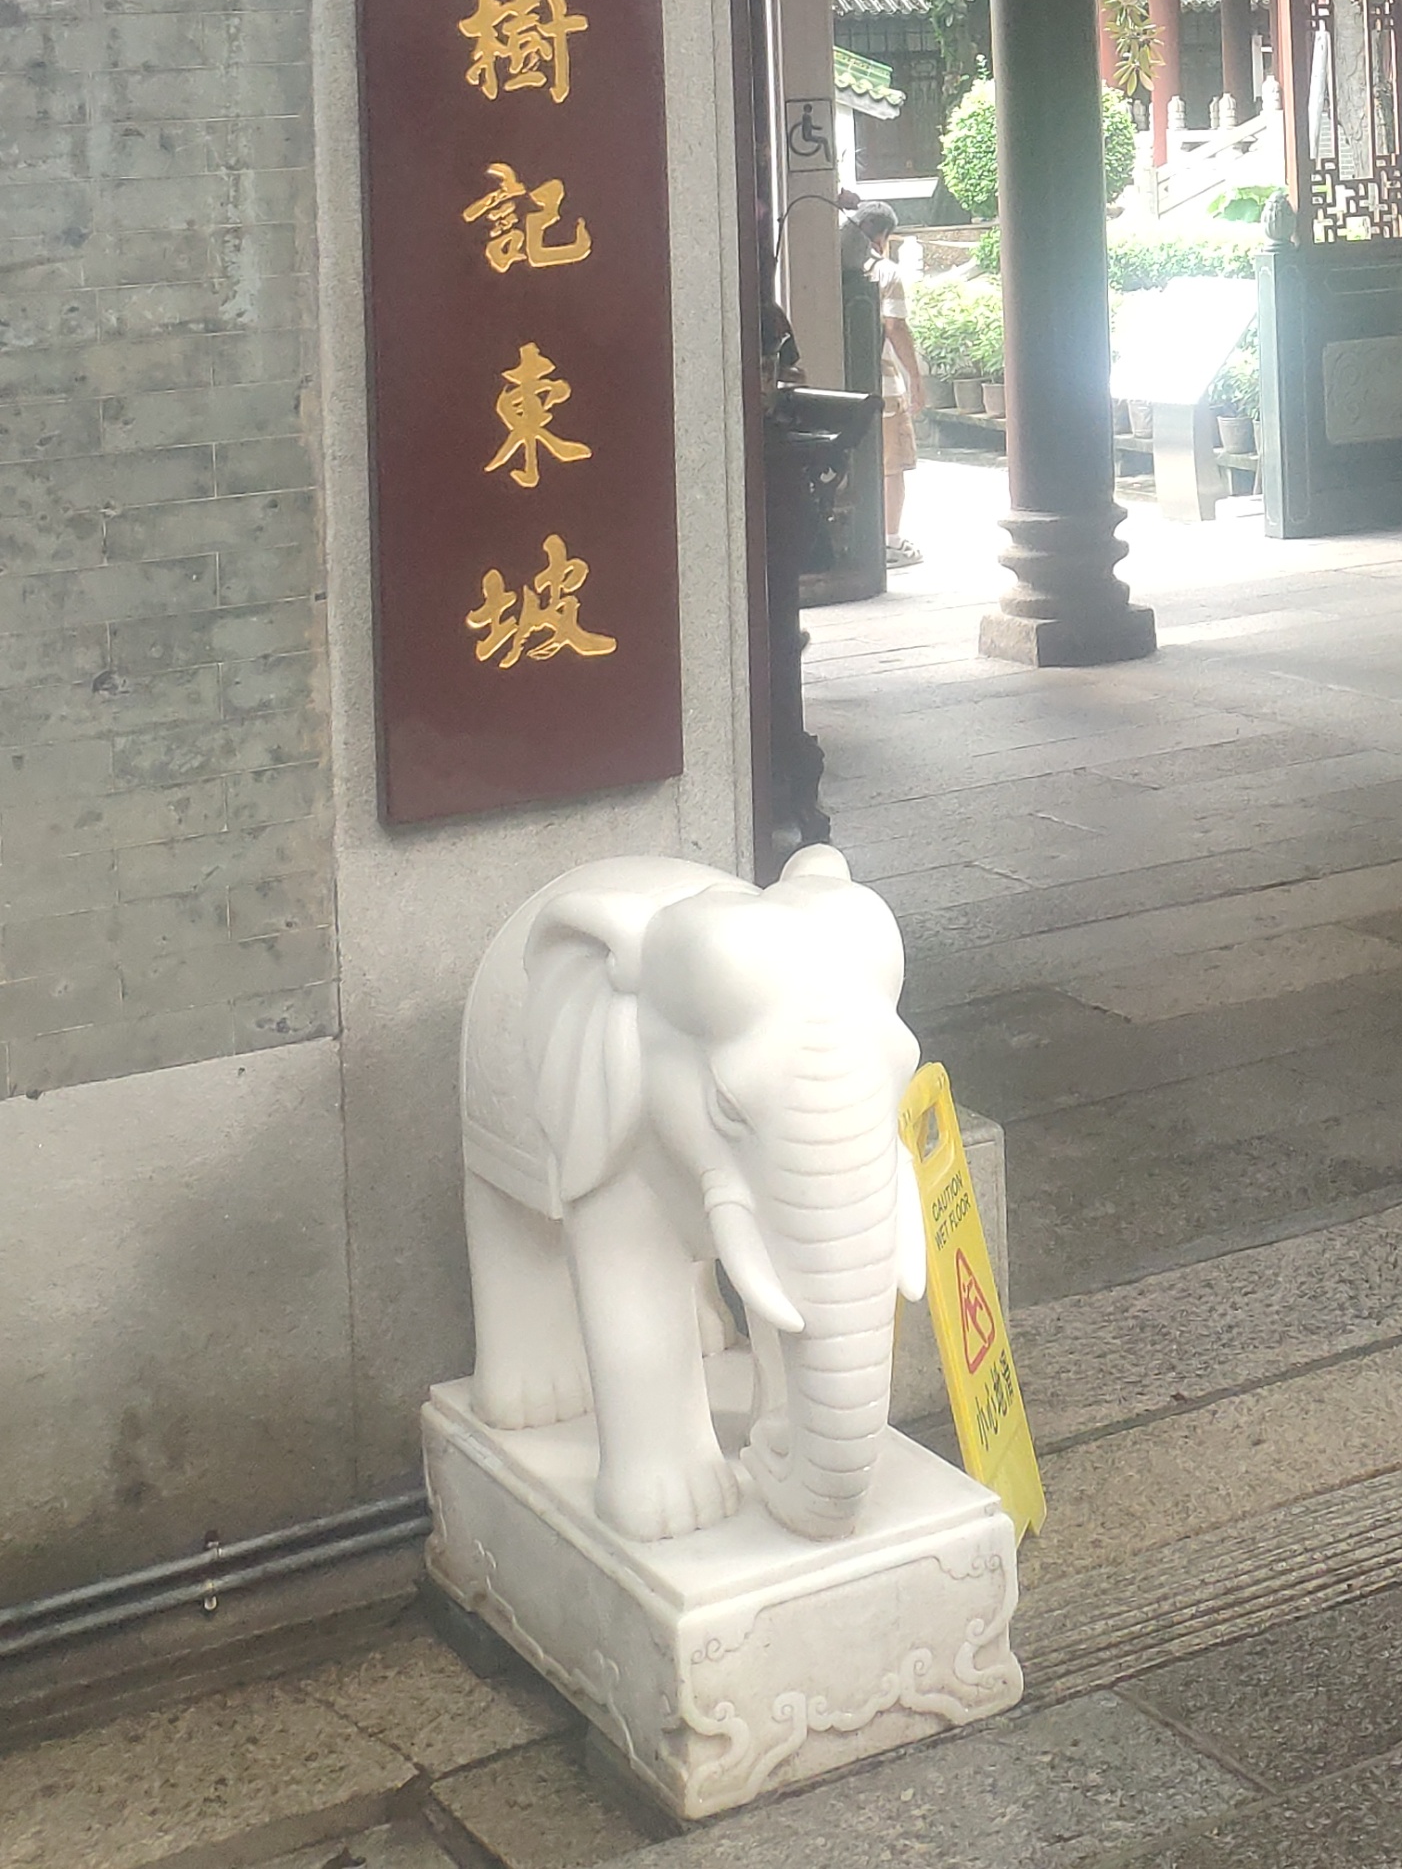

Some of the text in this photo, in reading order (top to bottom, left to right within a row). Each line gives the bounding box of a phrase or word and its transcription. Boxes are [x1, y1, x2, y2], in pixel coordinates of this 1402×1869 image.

[932, 1170, 964, 1222] CAUTION
[935, 1192, 972, 1251] WET FLOOR
[974, 1348, 1014, 1452] 小心地滑
